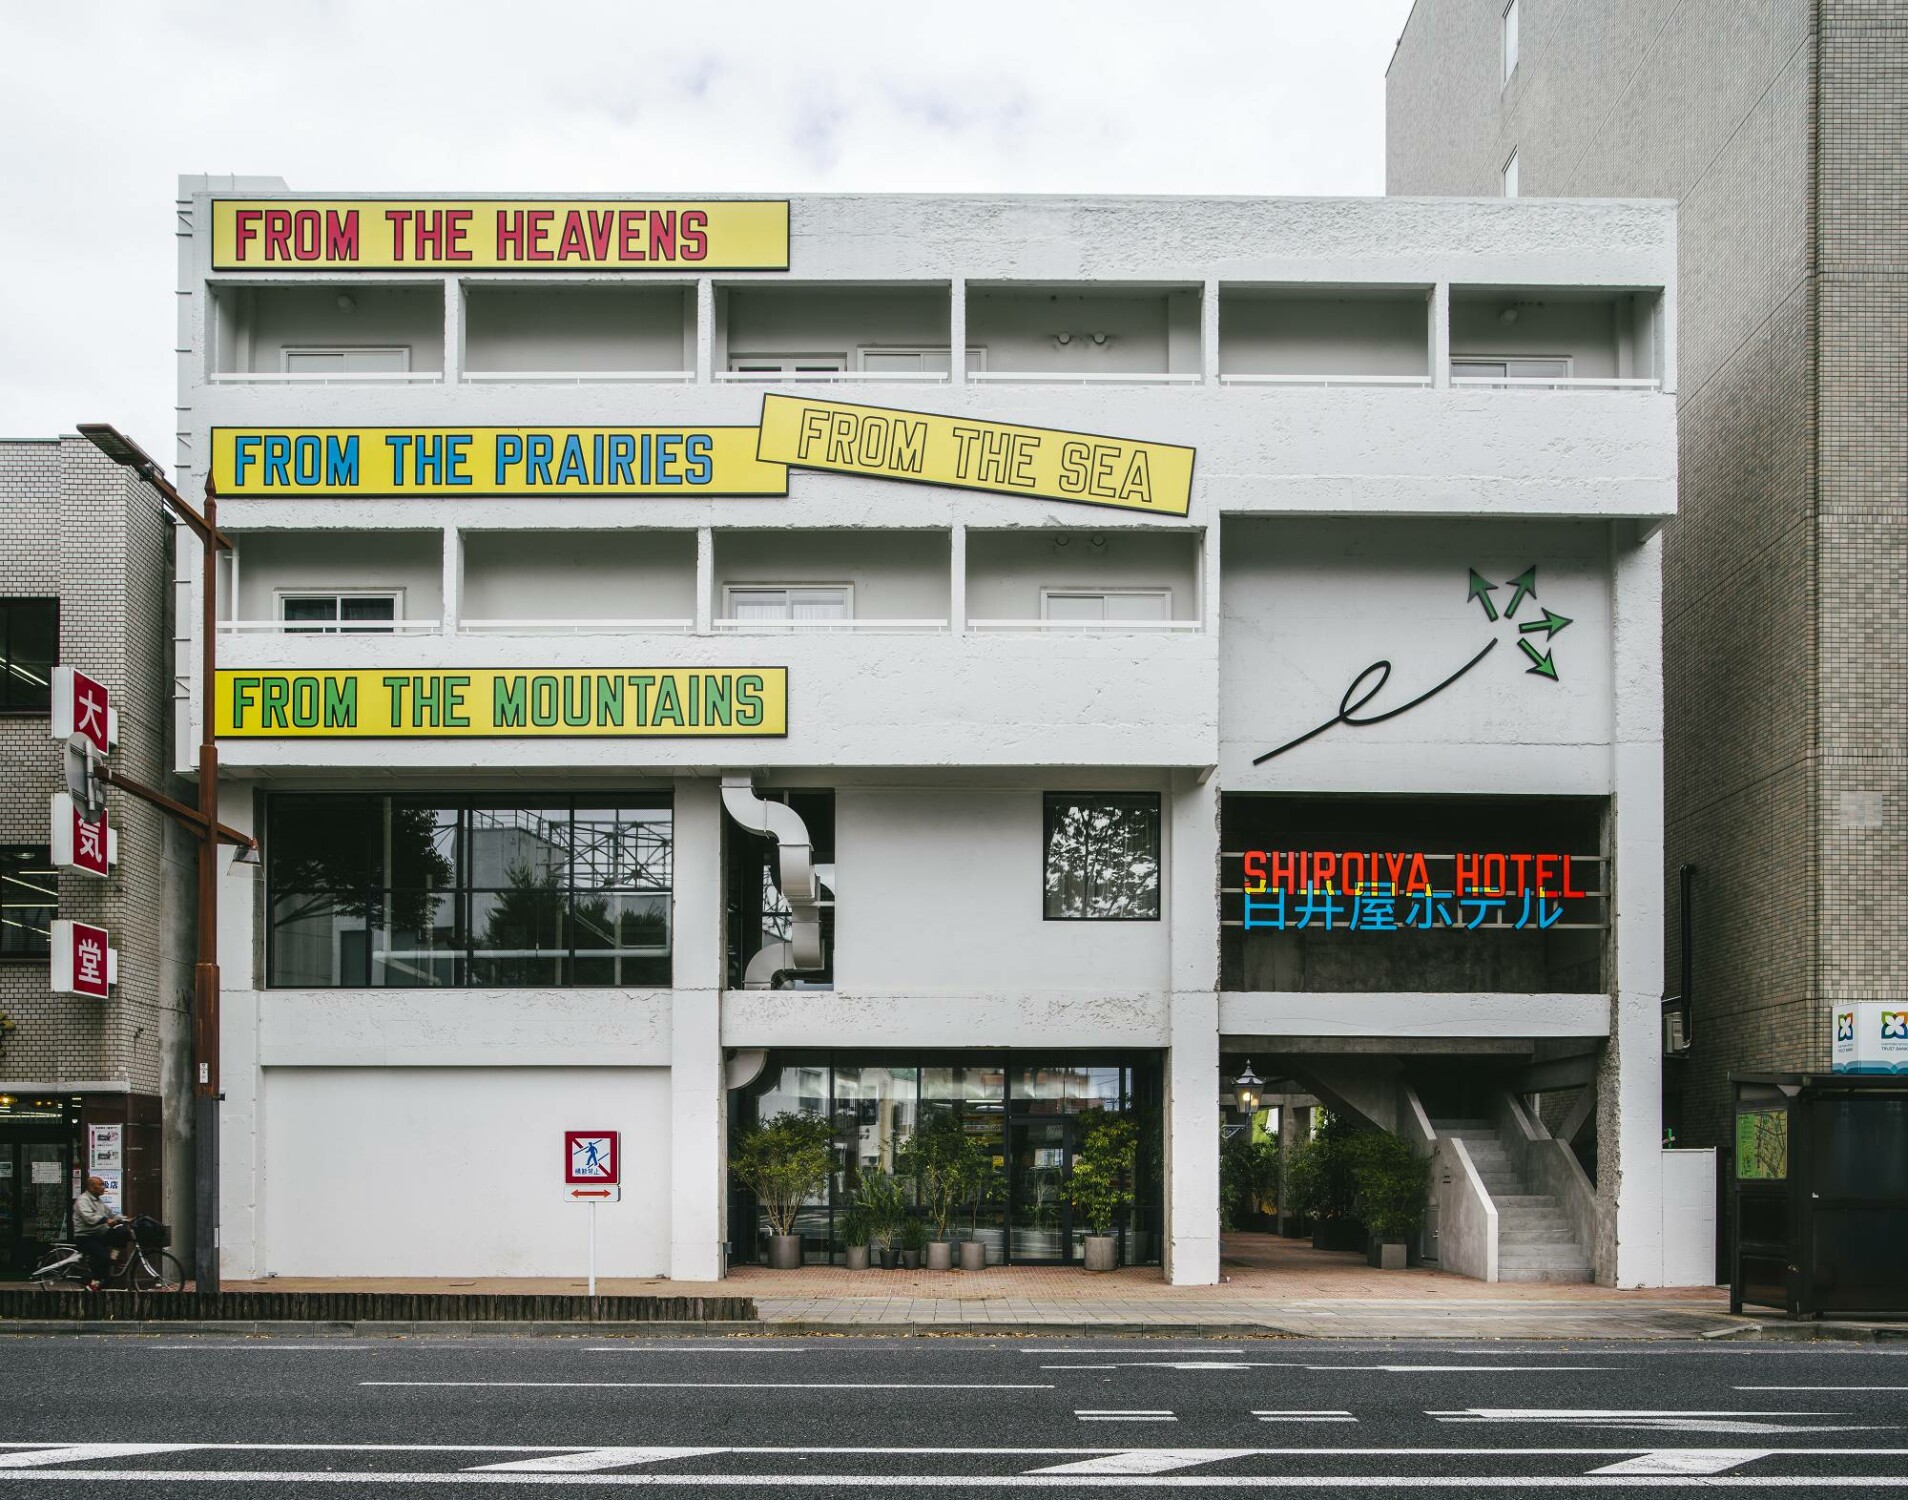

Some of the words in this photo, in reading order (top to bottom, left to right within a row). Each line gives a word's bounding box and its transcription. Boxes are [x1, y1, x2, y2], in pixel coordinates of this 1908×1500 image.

[235, 209, 359, 261] FROM
[385, 209, 473, 261] THE
[496, 209, 709, 261] HEAVENS
[234, 435, 360, 487] FROM
[385, 434, 473, 486] THE
[495, 434, 714, 486] PRAIRIES
[797, 408, 928, 474] FROM
[953, 427, 1041, 488] THE
[1059, 441, 1152, 503] SEA
[233, 677, 358, 728] FROM
[383, 676, 471, 728] THE
[493, 675, 765, 728] MOUNTAINS
[1243, 851, 1432, 898] SHIROIYA
[1455, 852, 1586, 899] HOTEL
[1243, 880, 1564, 931] 白井屋ホテル
